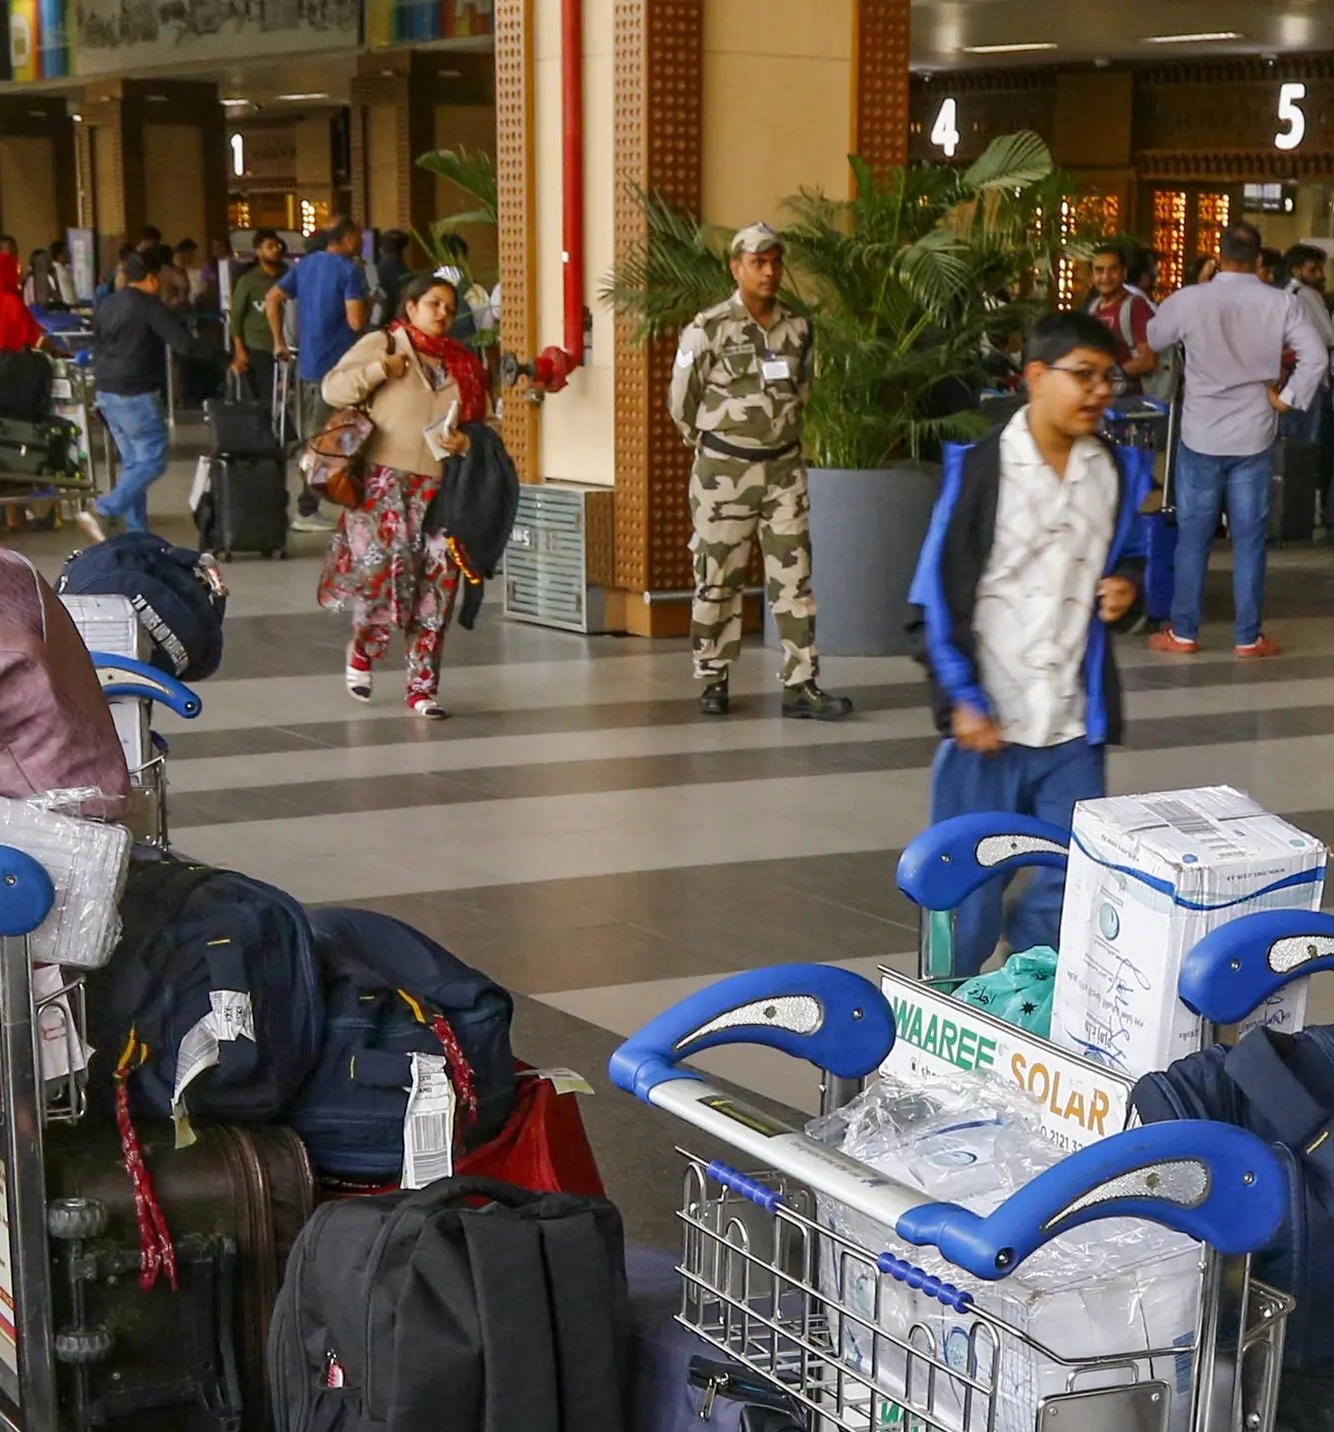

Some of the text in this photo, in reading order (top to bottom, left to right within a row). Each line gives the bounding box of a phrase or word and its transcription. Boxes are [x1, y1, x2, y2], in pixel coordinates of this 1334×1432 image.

[930, 98, 960, 157] 4
[1274, 82, 1306, 151] 5
[894, 997, 996, 1074] WAAREE
[1011, 1052, 1110, 1136] SOLAR
